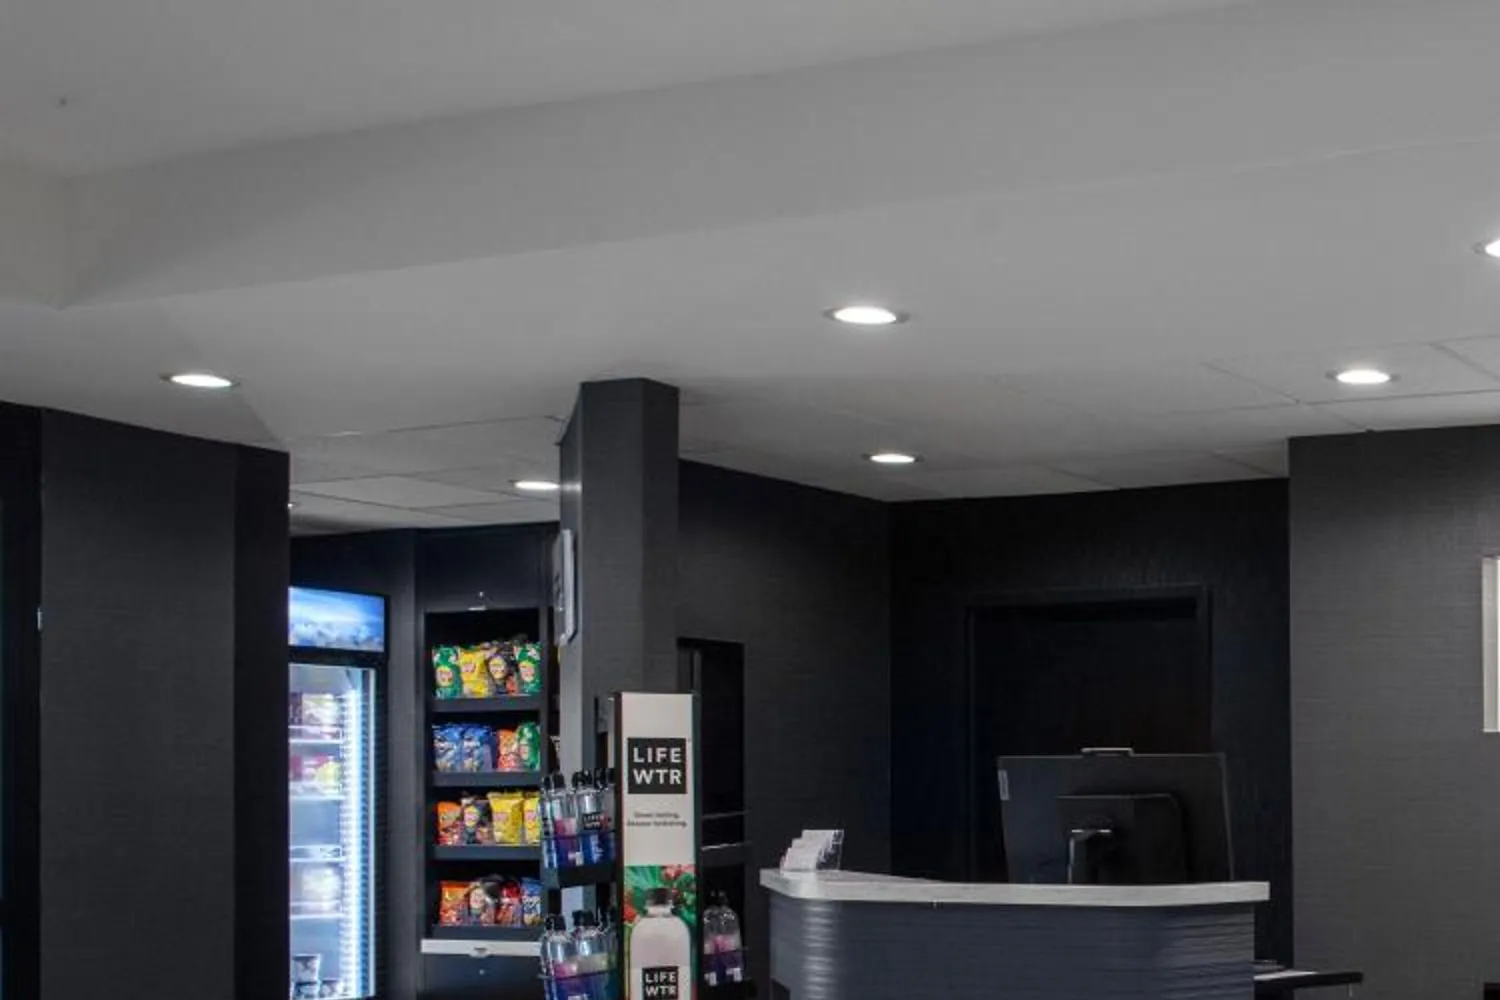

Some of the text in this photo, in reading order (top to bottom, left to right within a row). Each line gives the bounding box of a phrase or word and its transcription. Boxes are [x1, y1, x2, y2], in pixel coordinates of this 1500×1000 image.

[633, 747, 681, 763] LIFE
[633, 768, 681, 785] WTR
[645, 971, 677, 983] LIFE
[645, 985, 677, 997] WTR
